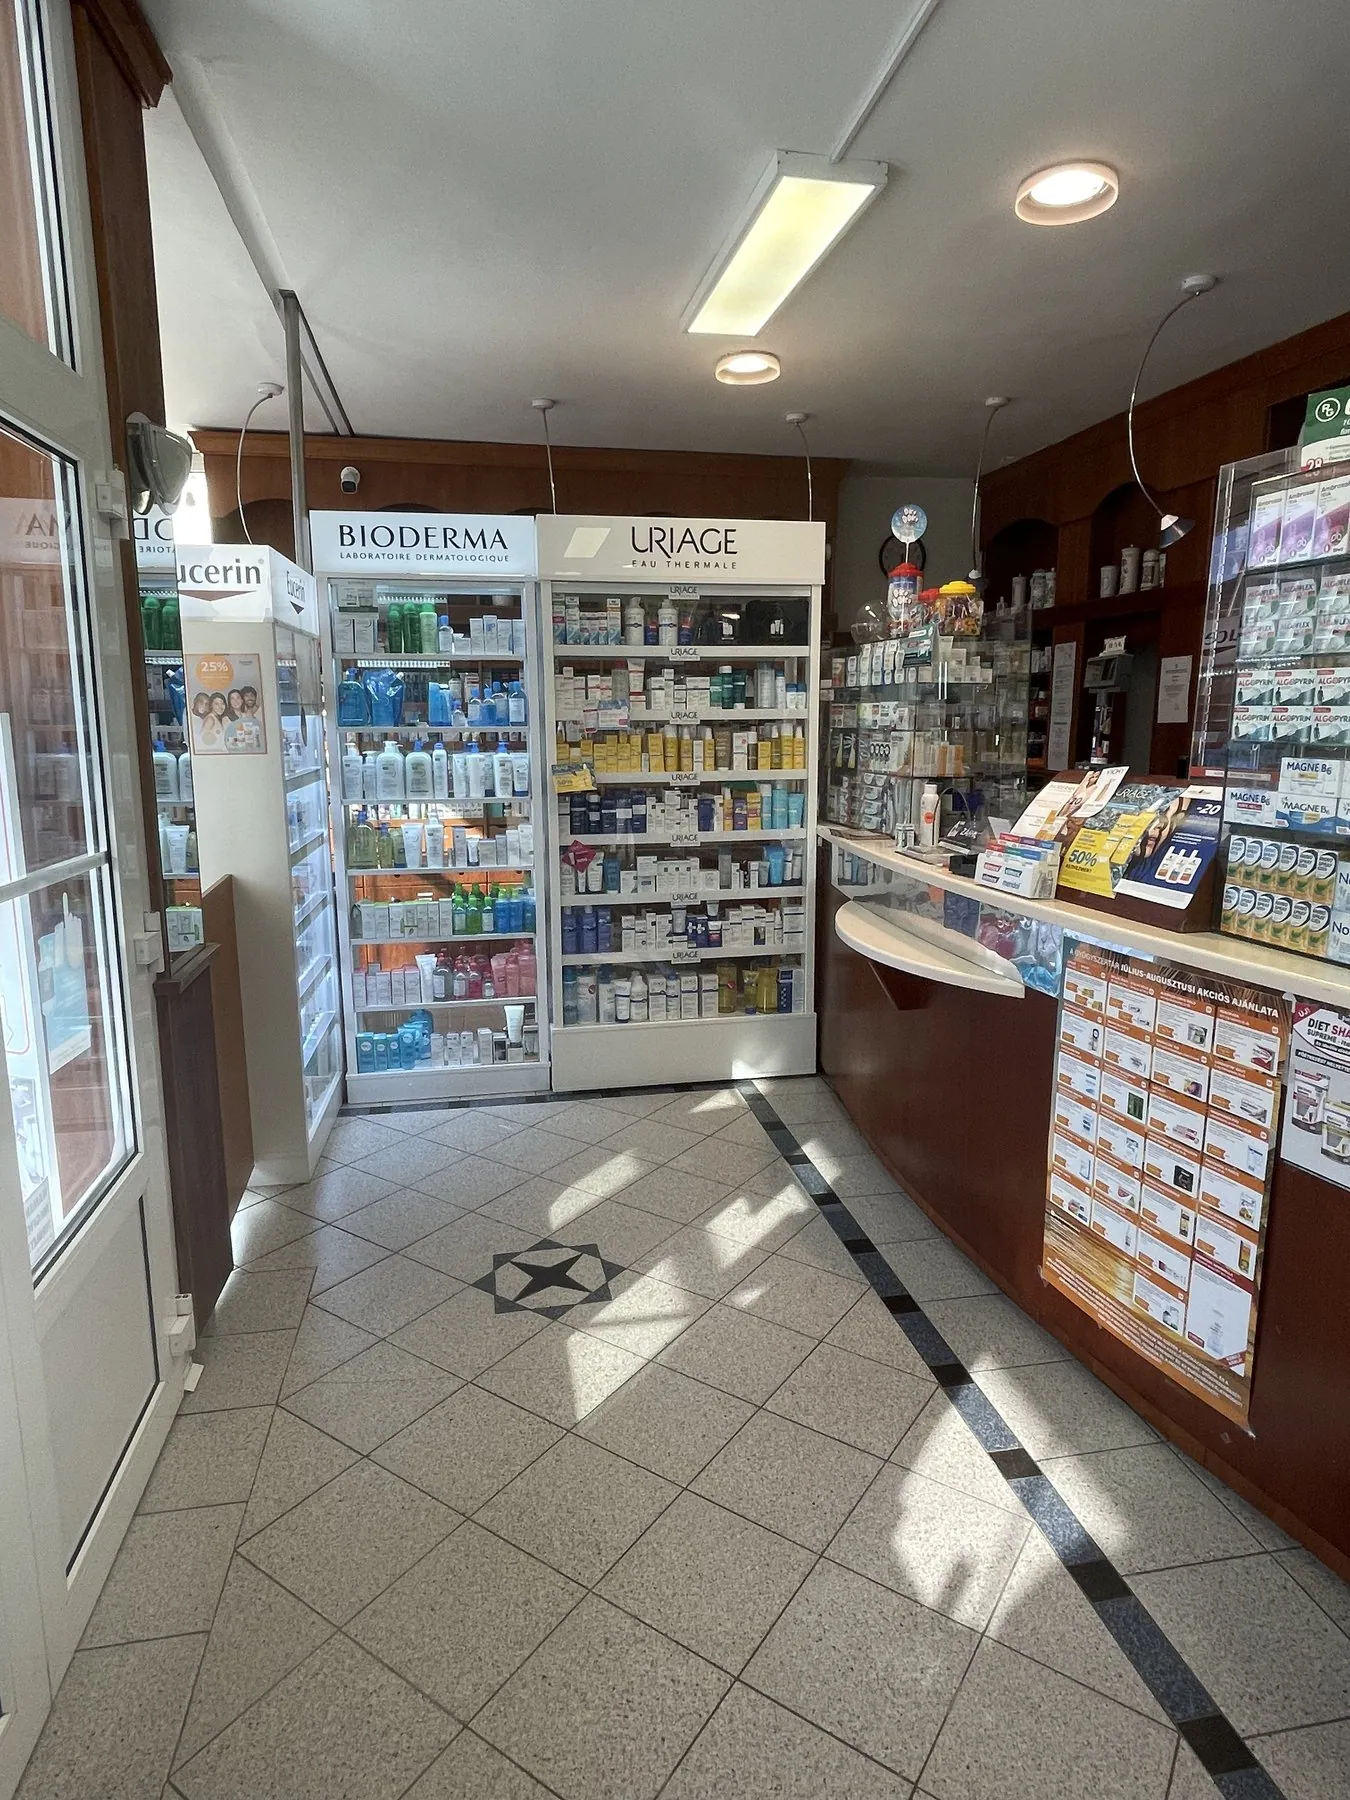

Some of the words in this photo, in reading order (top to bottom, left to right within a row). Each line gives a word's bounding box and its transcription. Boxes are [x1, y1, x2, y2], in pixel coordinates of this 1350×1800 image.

[339, 525, 508, 550] BIODERMA
[631, 526, 738, 559] URIAGE
[340, 552, 411, 560] LABORATOIRE
[416, 553, 509, 563] DERMATOLOGIQUE
[632, 560, 657, 568] EAU
[666, 561, 737, 569] THERMALE
[670, 586, 698, 595] URIAGE
[670, 648, 698, 657] URIAGE
[200, 661, 229, 673] 25%
[1277, 678, 1314, 686] ALGOPYRIN
[671, 711, 698, 720] URIAGE
[1287, 762, 1319, 772] MAGNE
[671, 773, 698, 782] URIAGE
[1230, 792, 1259, 802] MAGNE
[1196, 804, 1221, 815] -20
[1284, 801, 1320, 813] MAGNE
[671, 834, 698, 843] URIAGE
[1068, 849, 1097, 867] 50%
[672, 892, 698, 902] URIAGE
[672, 951, 698, 960] URIAGE
[1121, 963, 1195, 994] JÚLIUS-AUGUSZTUSI
[1197, 988, 1230, 1004] AKCIÓS
[1231, 998, 1279, 1018] AJÁNLATA
[1308, 1018, 1331, 1032] DIET
[1307, 1029, 1337, 1043] SUPREME
